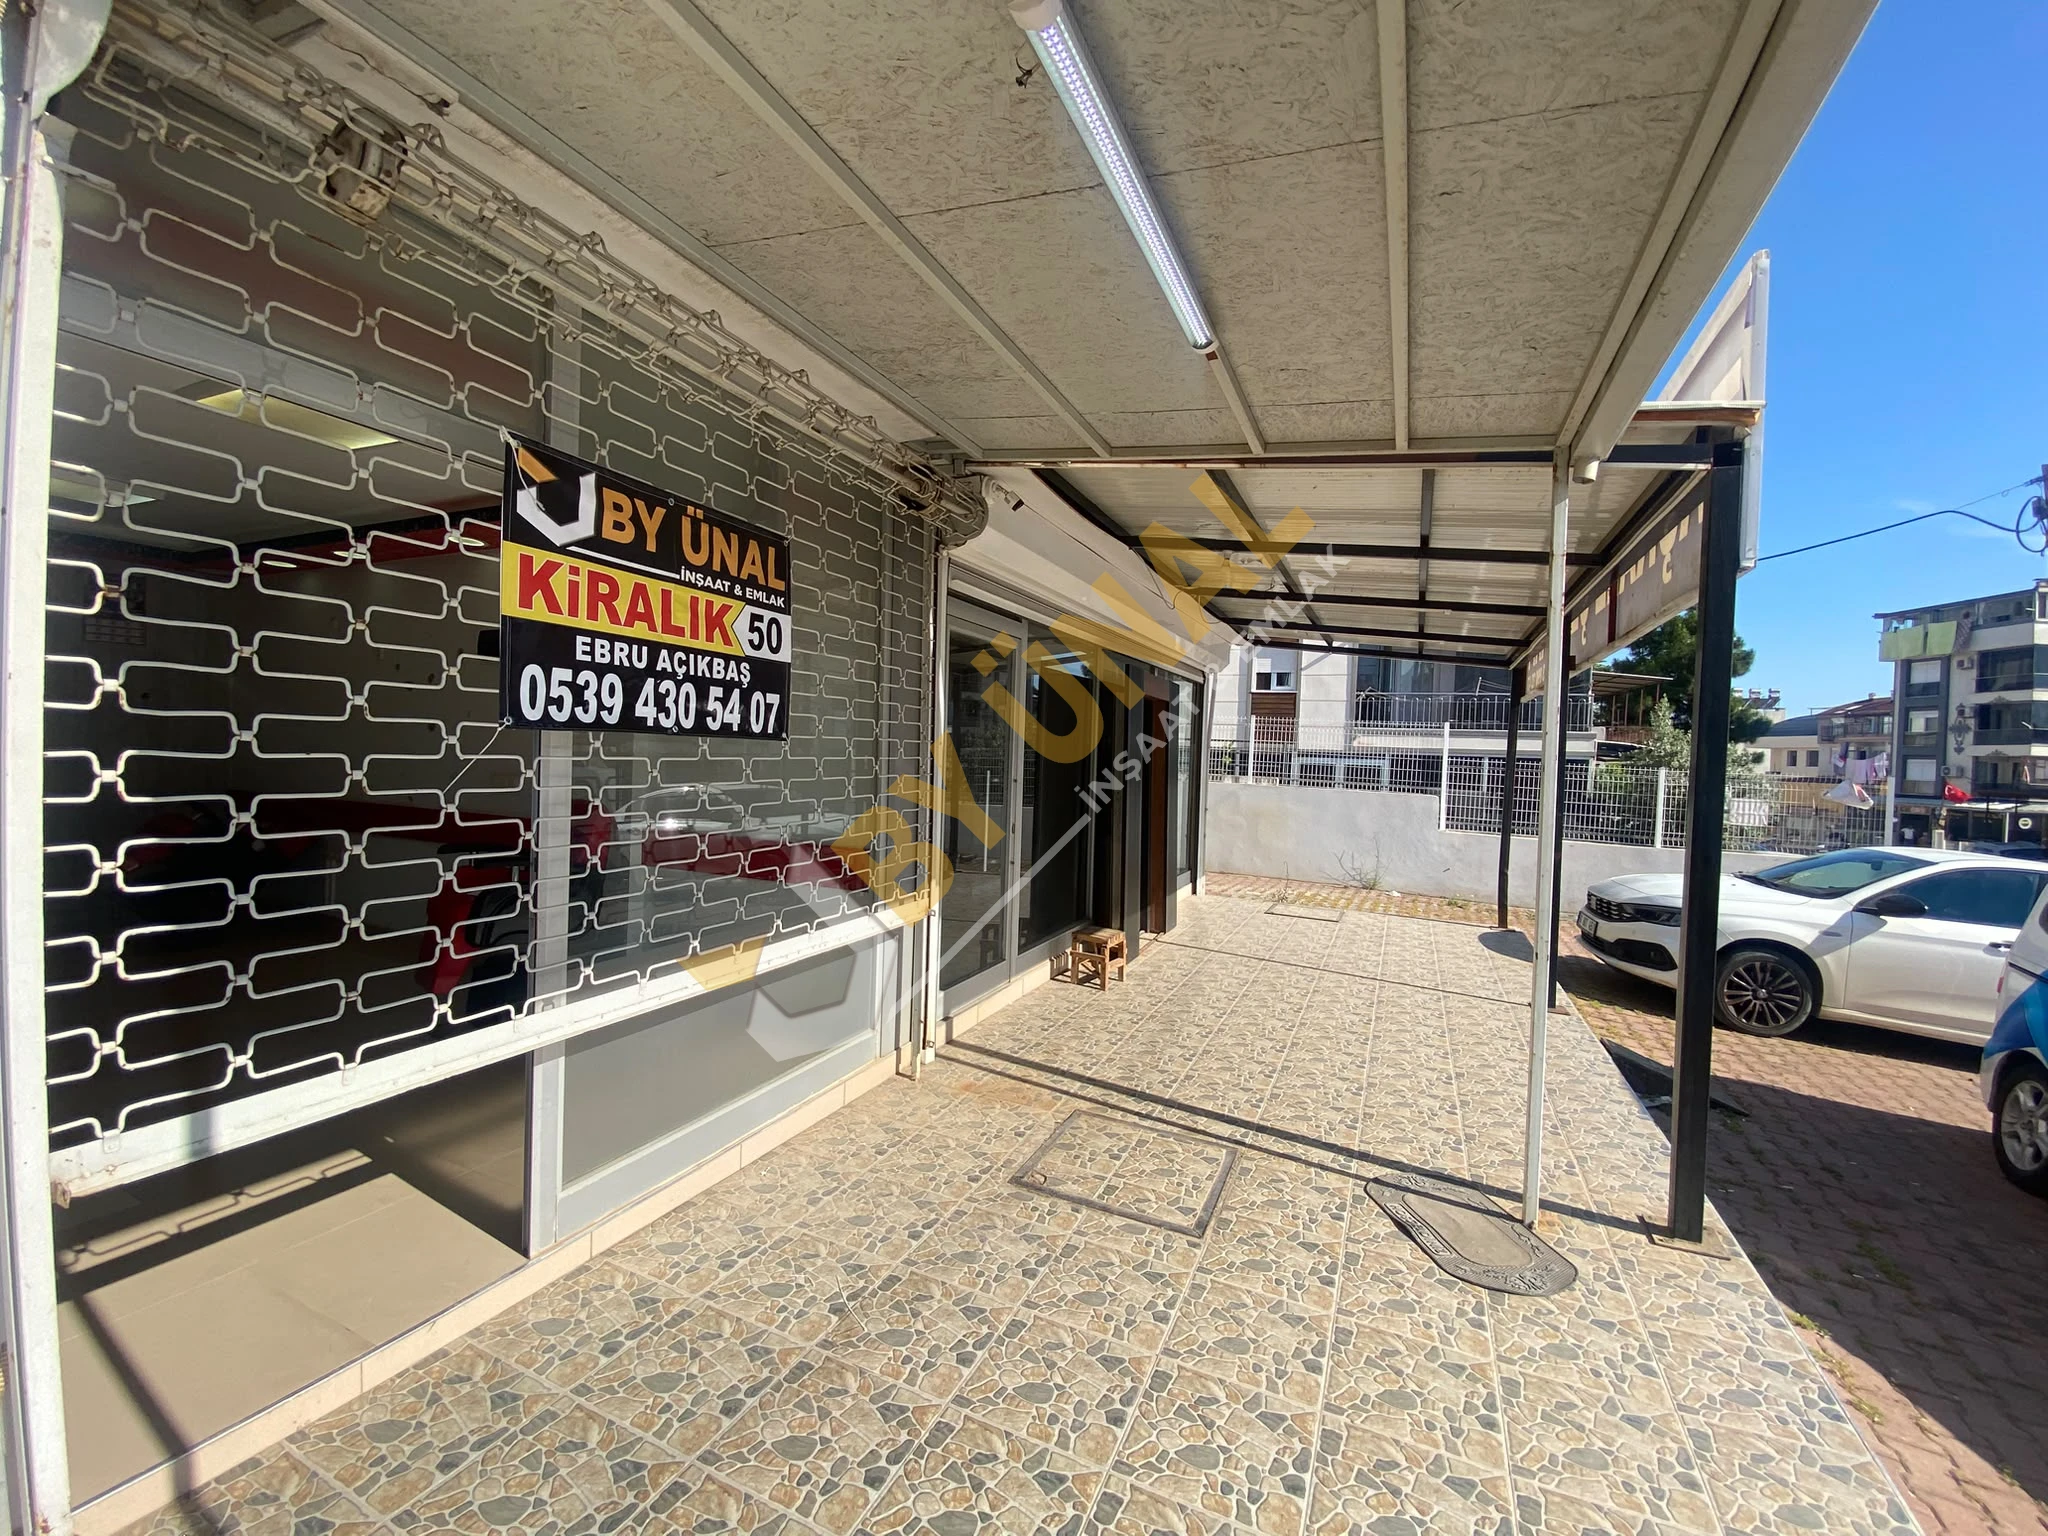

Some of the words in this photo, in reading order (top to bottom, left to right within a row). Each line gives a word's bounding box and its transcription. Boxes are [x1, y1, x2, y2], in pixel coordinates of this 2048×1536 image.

[601, 487, 667, 552] BY
[681, 505, 785, 591] ÜNAL
[680, 566, 731, 594] İNŞAAT
[733, 585, 743, 597] &
[745, 587, 785, 608] EMLAK
[747, 614, 783, 655] 50
[575, 635, 648, 669] EBRU
[656, 648, 751, 688] AÇIKBAŞ
[519, 663, 623, 725] 0539
[634, 677, 697, 730] 430
[706, 685, 741, 732] 54
[750, 691, 780, 734] 07
